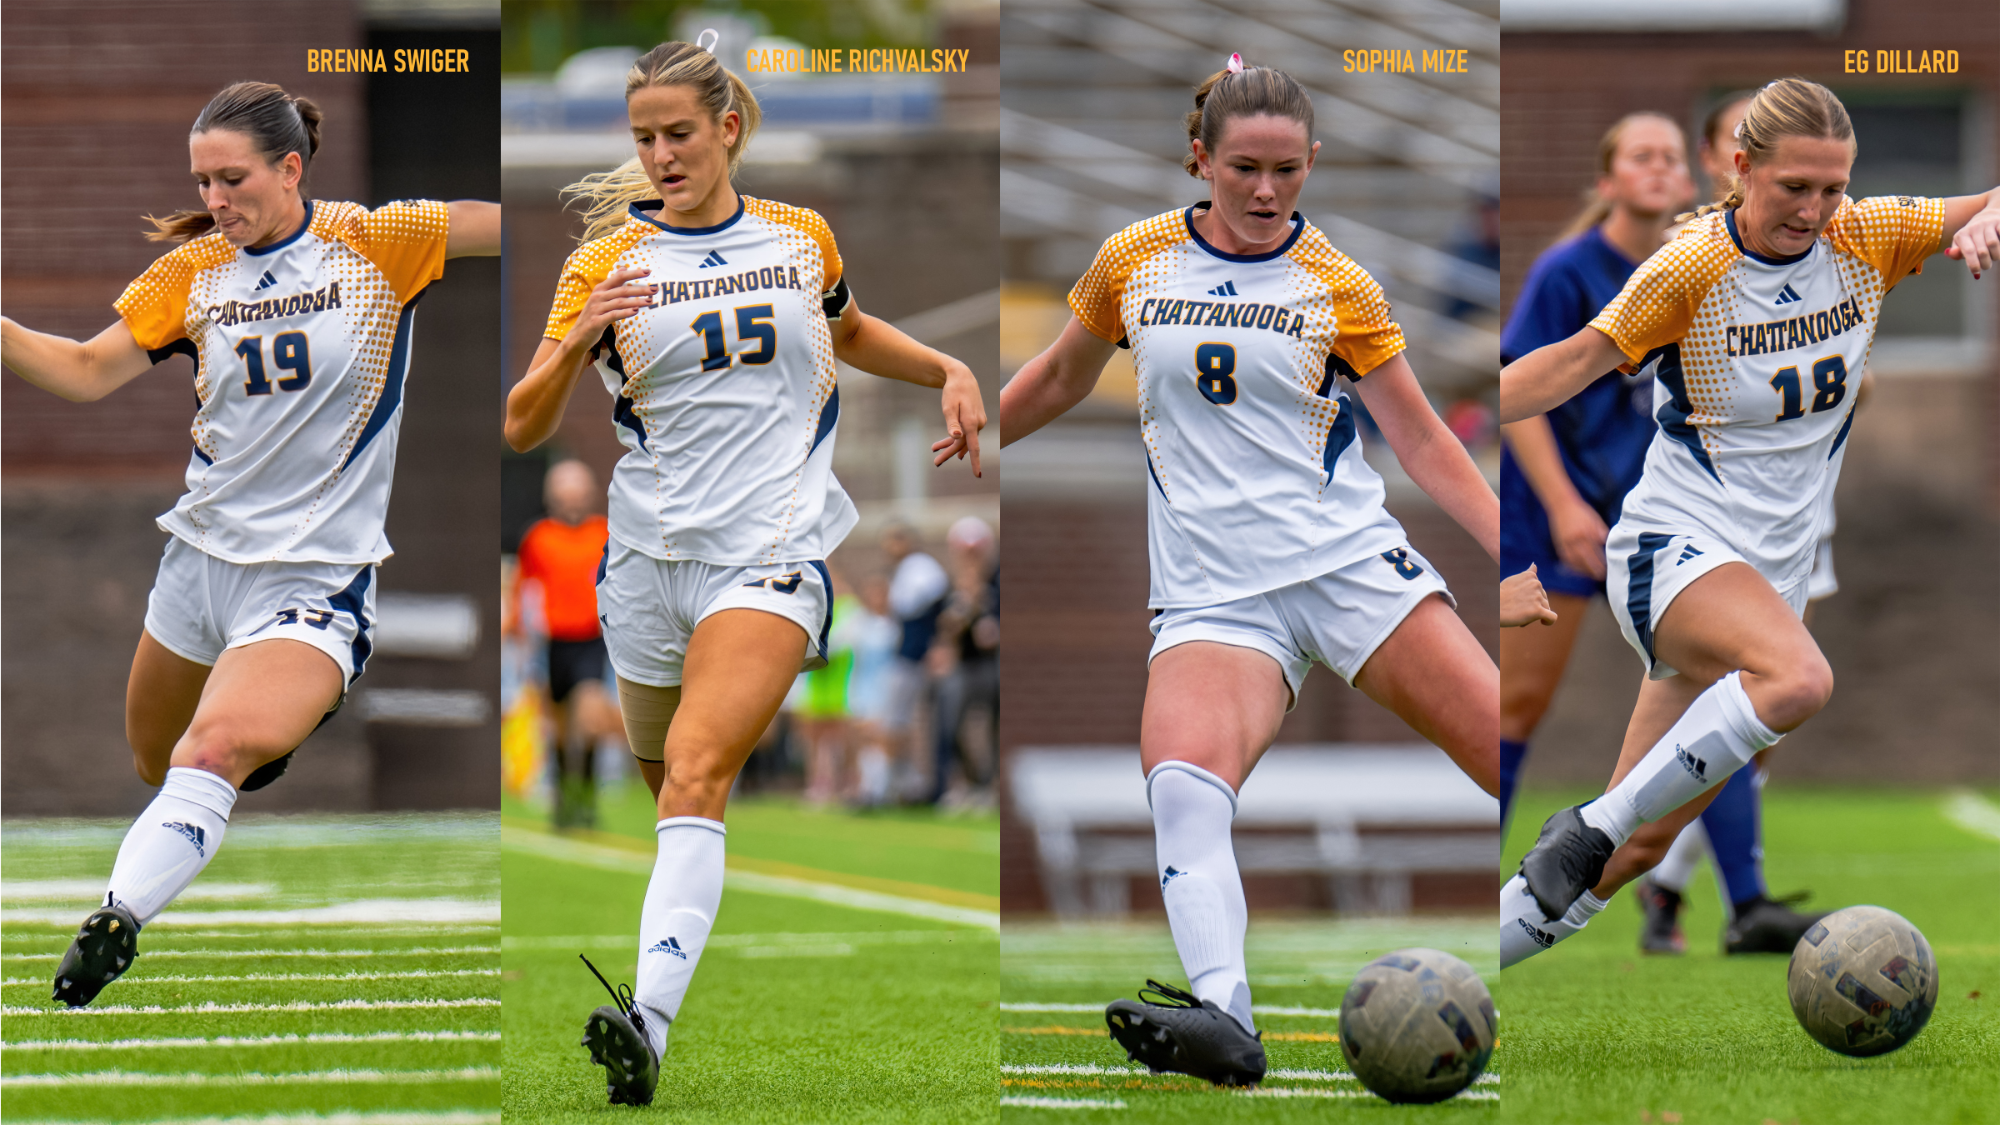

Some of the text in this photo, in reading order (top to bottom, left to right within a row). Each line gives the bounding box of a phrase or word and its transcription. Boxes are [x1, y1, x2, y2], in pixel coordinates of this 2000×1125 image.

[207, 281, 342, 326] CHATTANOOGA
[1140, 298, 1305, 338] CHATTANOOGA
[1726, 294, 1864, 357] CHATTANOOGA
[233, 329, 313, 397] 19
[689, 303, 777, 373] 15
[1194, 341, 1239, 406] 8
[1768, 353, 1849, 423] 18
[1380, 546, 1424, 581] 8
[161, 821, 205, 858] adidas
[647, 943, 687, 960] adidas
